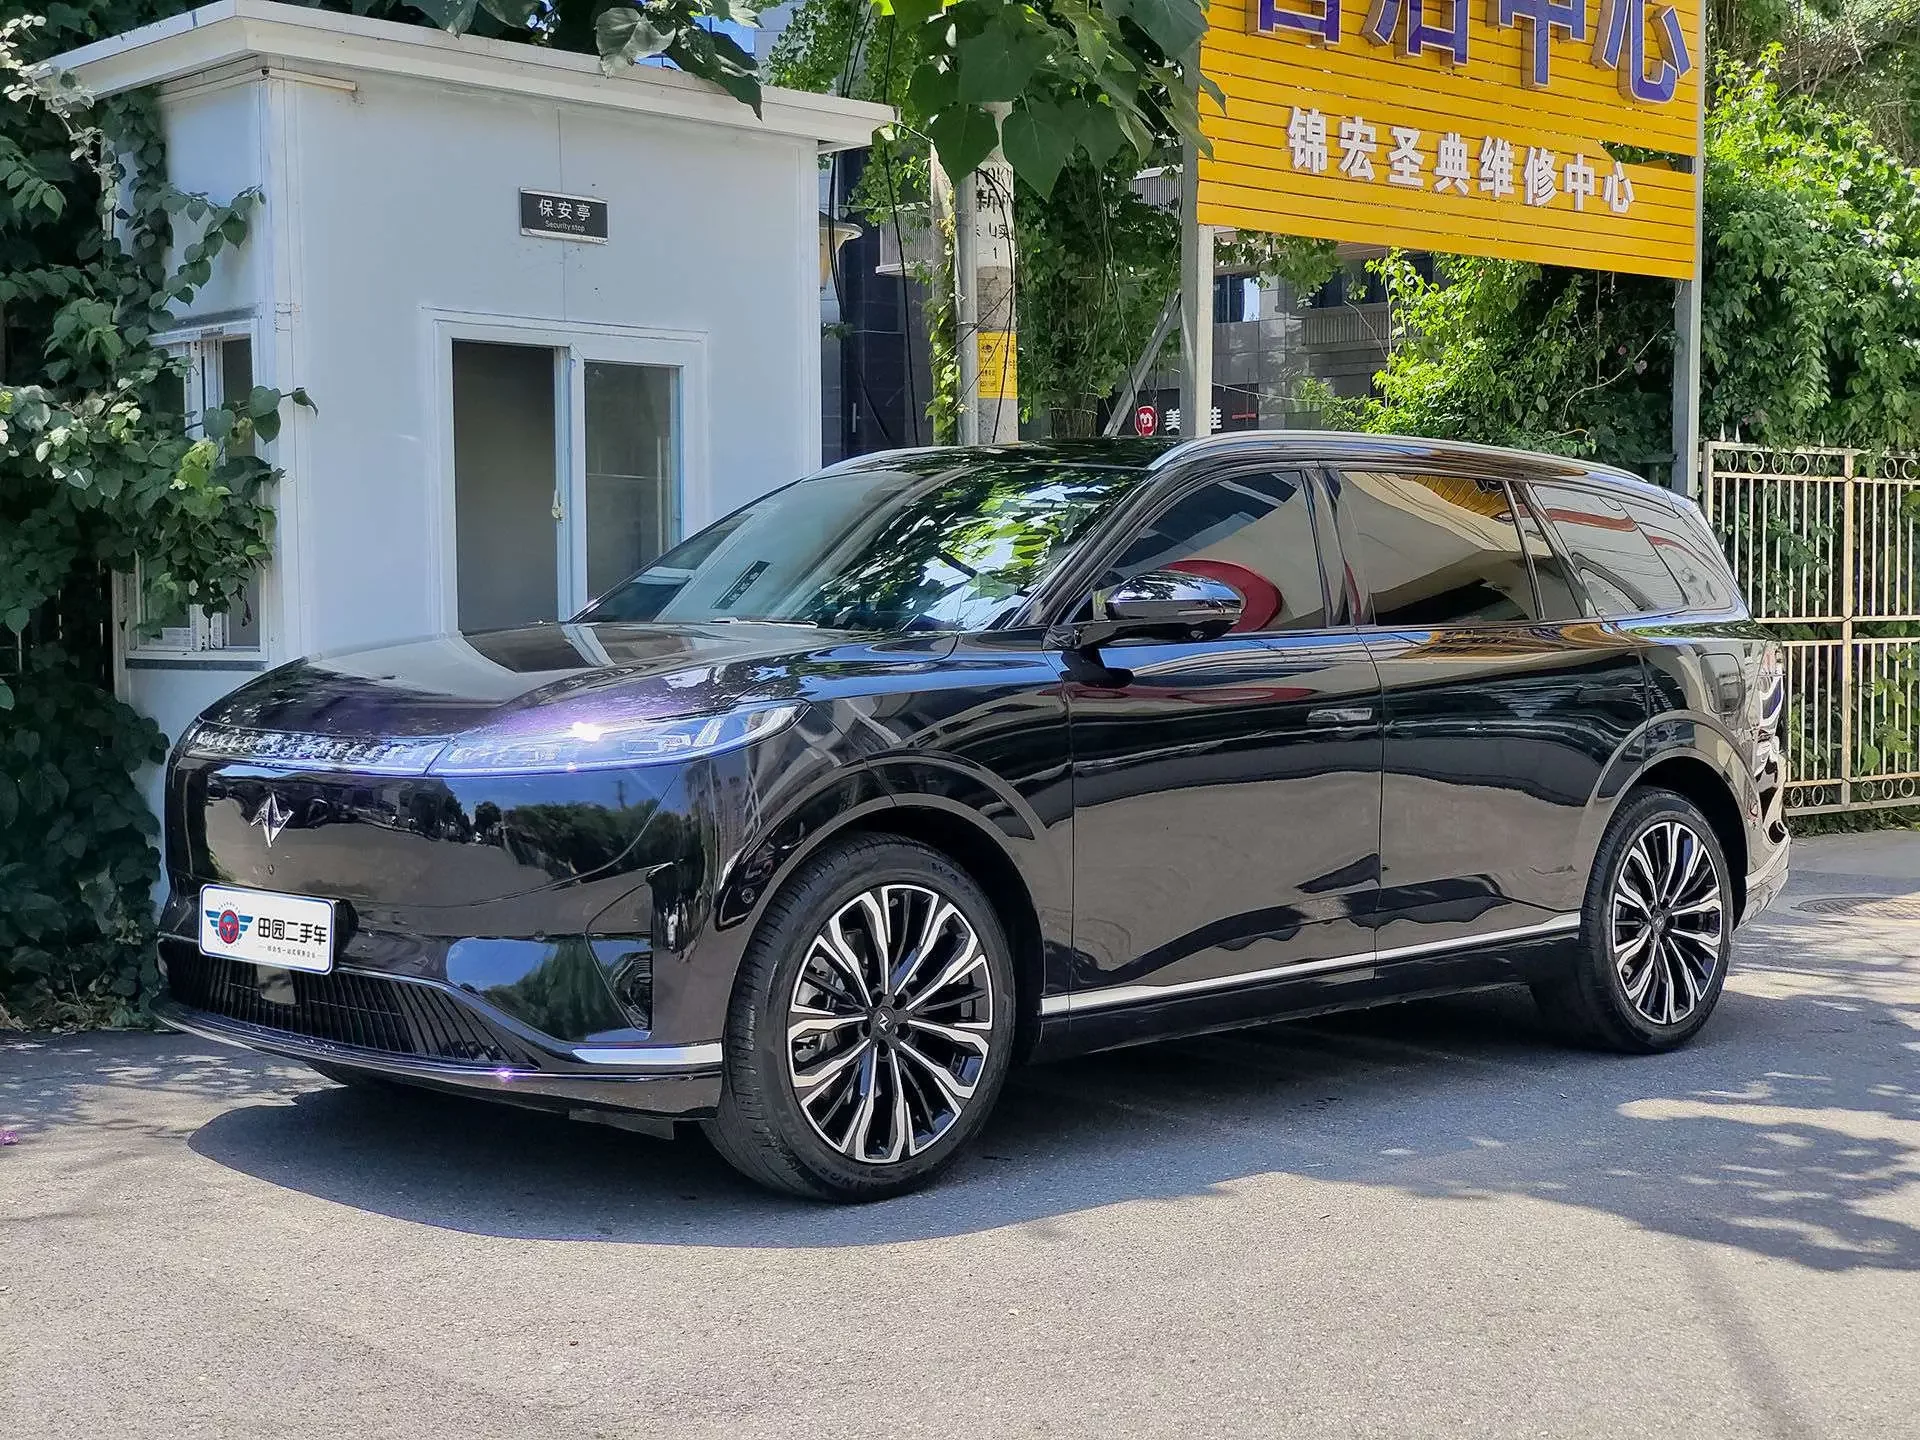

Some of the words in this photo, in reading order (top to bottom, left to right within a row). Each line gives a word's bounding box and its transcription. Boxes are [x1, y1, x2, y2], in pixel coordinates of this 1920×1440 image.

[1286, 105, 1635, 214] 锦宏圣典维修中心
[539, 198, 591, 221] 保安亭
[545, 220, 571, 231] Security
[571, 223, 585, 233] stop
[258, 917, 327, 946] 田园二手车
